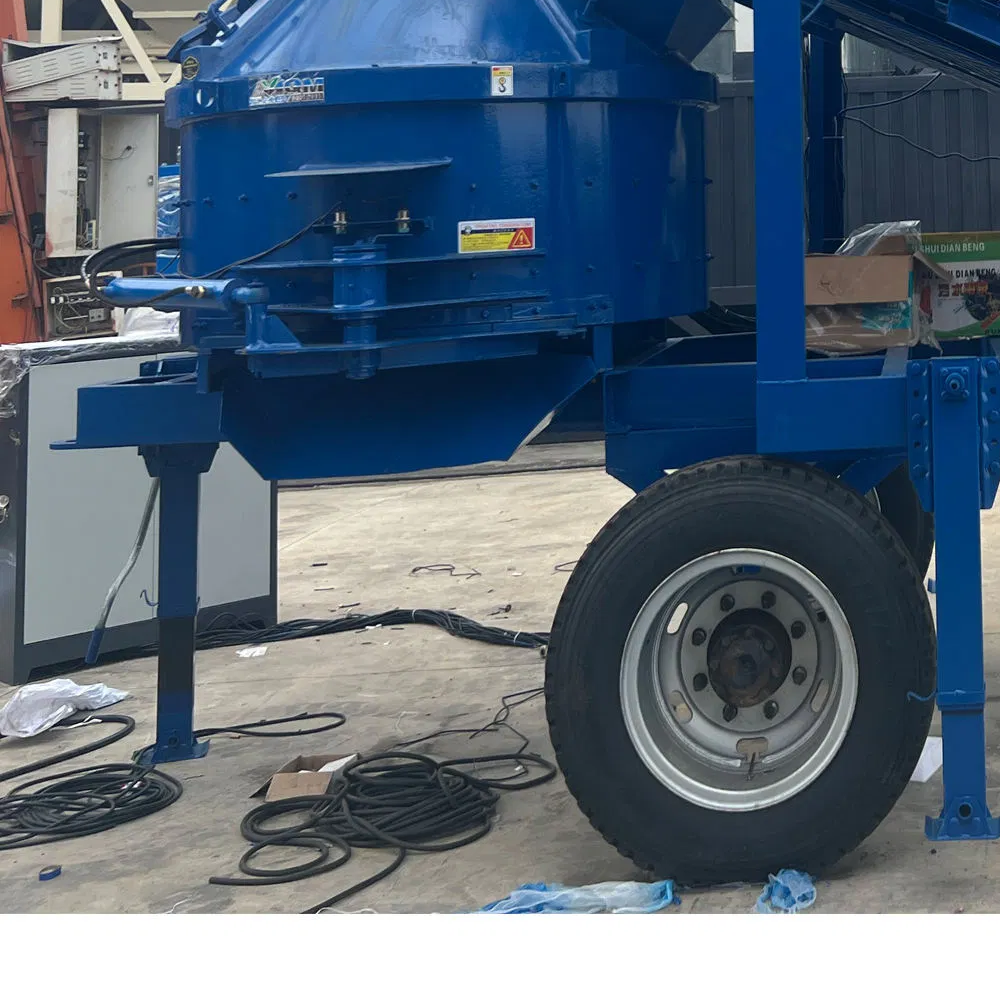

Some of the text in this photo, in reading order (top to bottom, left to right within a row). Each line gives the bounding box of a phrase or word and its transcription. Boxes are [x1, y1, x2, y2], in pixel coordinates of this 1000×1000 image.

[940, 244, 960, 253] DIAN
[962, 242, 985, 252] BENG
[955, 269, 975, 278] DIAN
